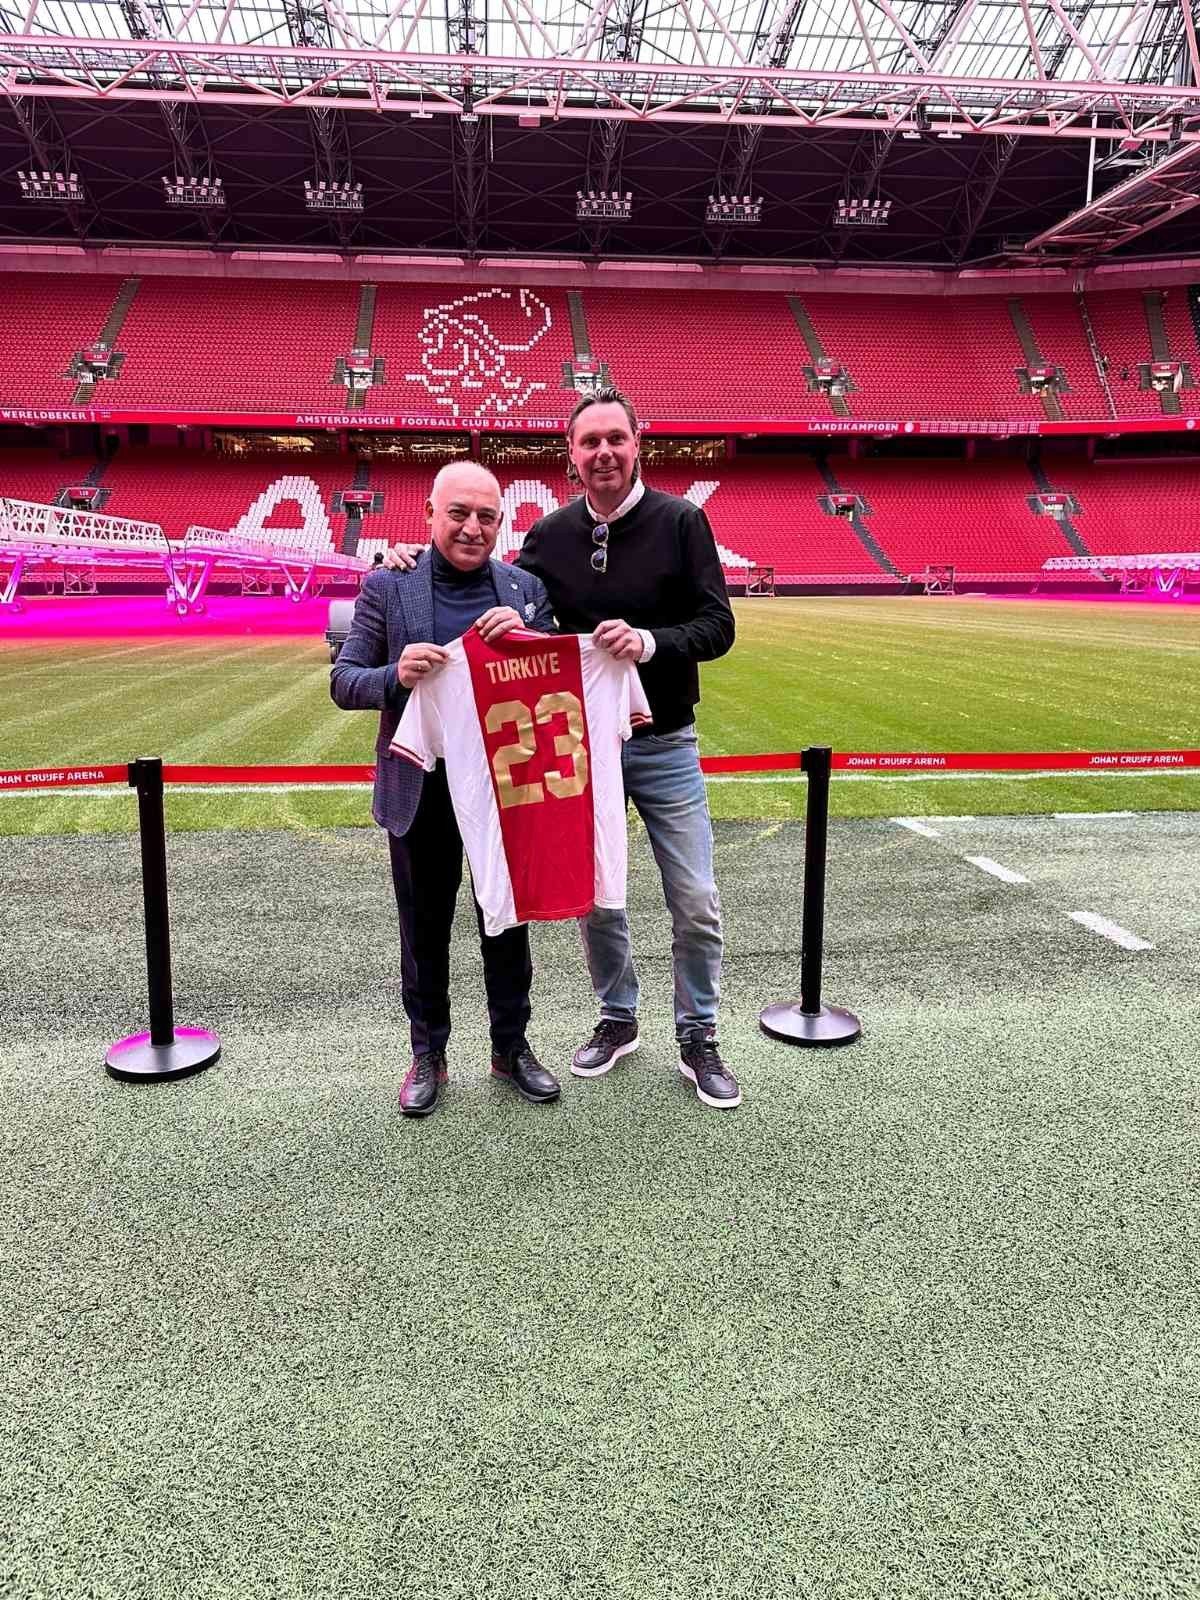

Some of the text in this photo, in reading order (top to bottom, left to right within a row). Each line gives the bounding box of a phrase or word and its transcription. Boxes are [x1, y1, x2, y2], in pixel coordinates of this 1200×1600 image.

[1, 410, 86, 420] WERELDBEKER
[296, 415, 395, 425] AMSTERDAMSCHE
[401, 417, 457, 427] FOOTBALL
[462, 418, 490, 427] CLUB
[494, 420, 522, 429] AJAX
[527, 420, 559, 429] SINDS
[808, 422, 898, 432] LANDSKAMPIOEN
[485, 652, 561, 685] TURKIYE
[484, 691, 589, 809] 23
[847, 757, 876, 766] JOHAN
[914, 757, 946, 766] ARENA
[1089, 755, 1118, 765] JOHAN
[1154, 754, 1184, 764] ARENA
[67, 771, 105, 781] ARENA
